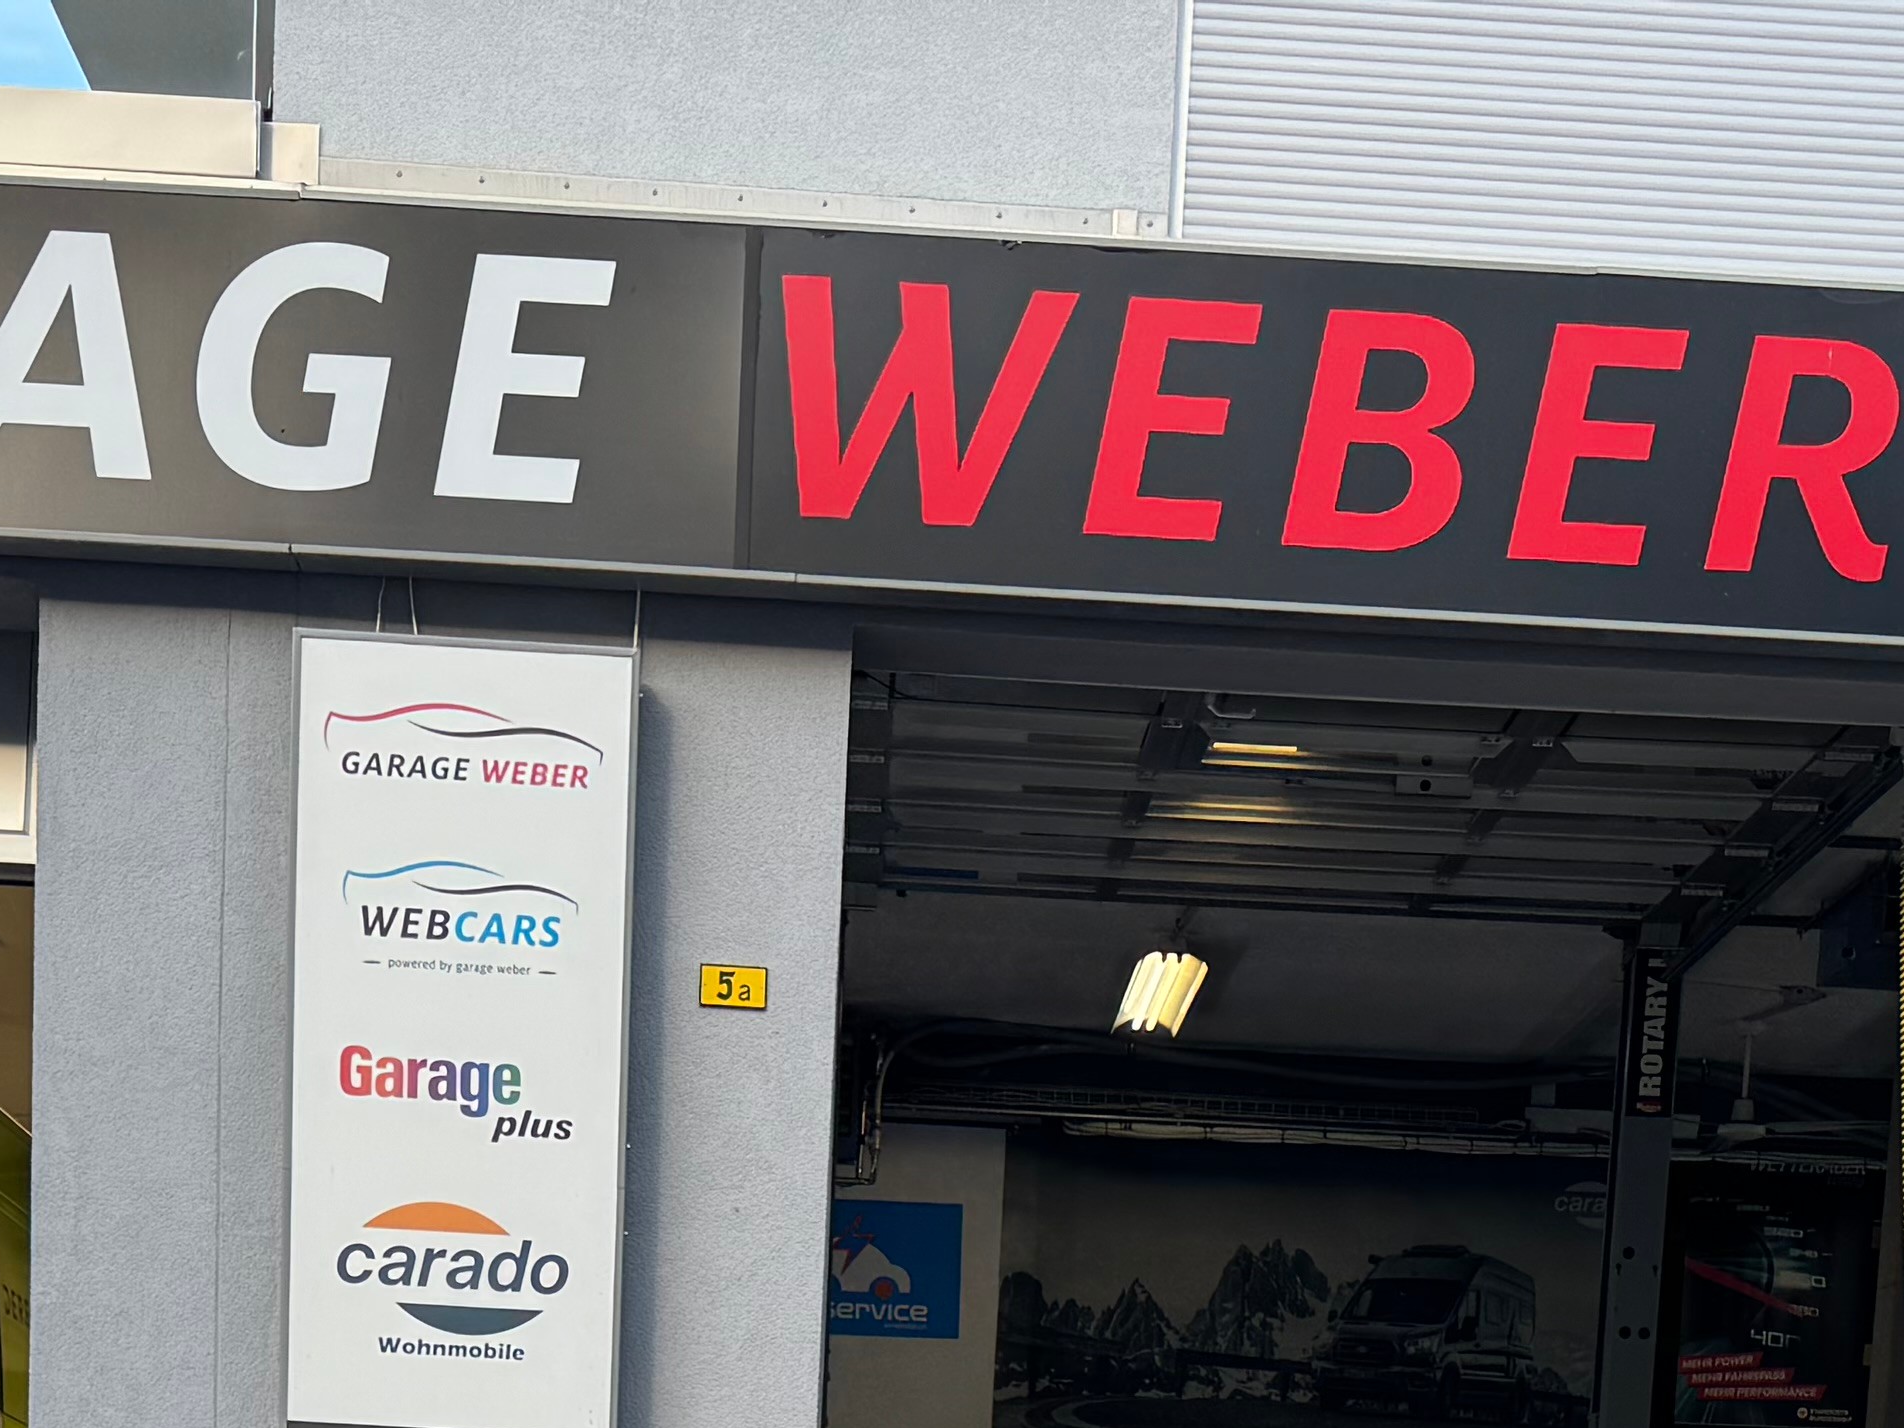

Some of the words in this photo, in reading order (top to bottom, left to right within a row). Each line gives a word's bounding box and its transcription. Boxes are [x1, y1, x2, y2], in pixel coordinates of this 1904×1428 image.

[781, 274, 1900, 582] WEBER
[342, 751, 470, 781] GARAGE
[481, 759, 589, 789] WEBER
[361, 905, 560, 948] WEBCARS
[388, 958, 435, 973] powered
[439, 960, 452, 974] by
[456, 961, 493, 976] garage
[497, 963, 531, 976] weber
[1639, 976, 1669, 1097] ROTARY
[340, 1045, 521, 1118] Garage
[492, 1110, 572, 1143] plus
[1554, 1196, 1607, 1213] cara
[336, 1240, 569, 1295] carado
[378, 1336, 525, 1361] Wohnmobile
